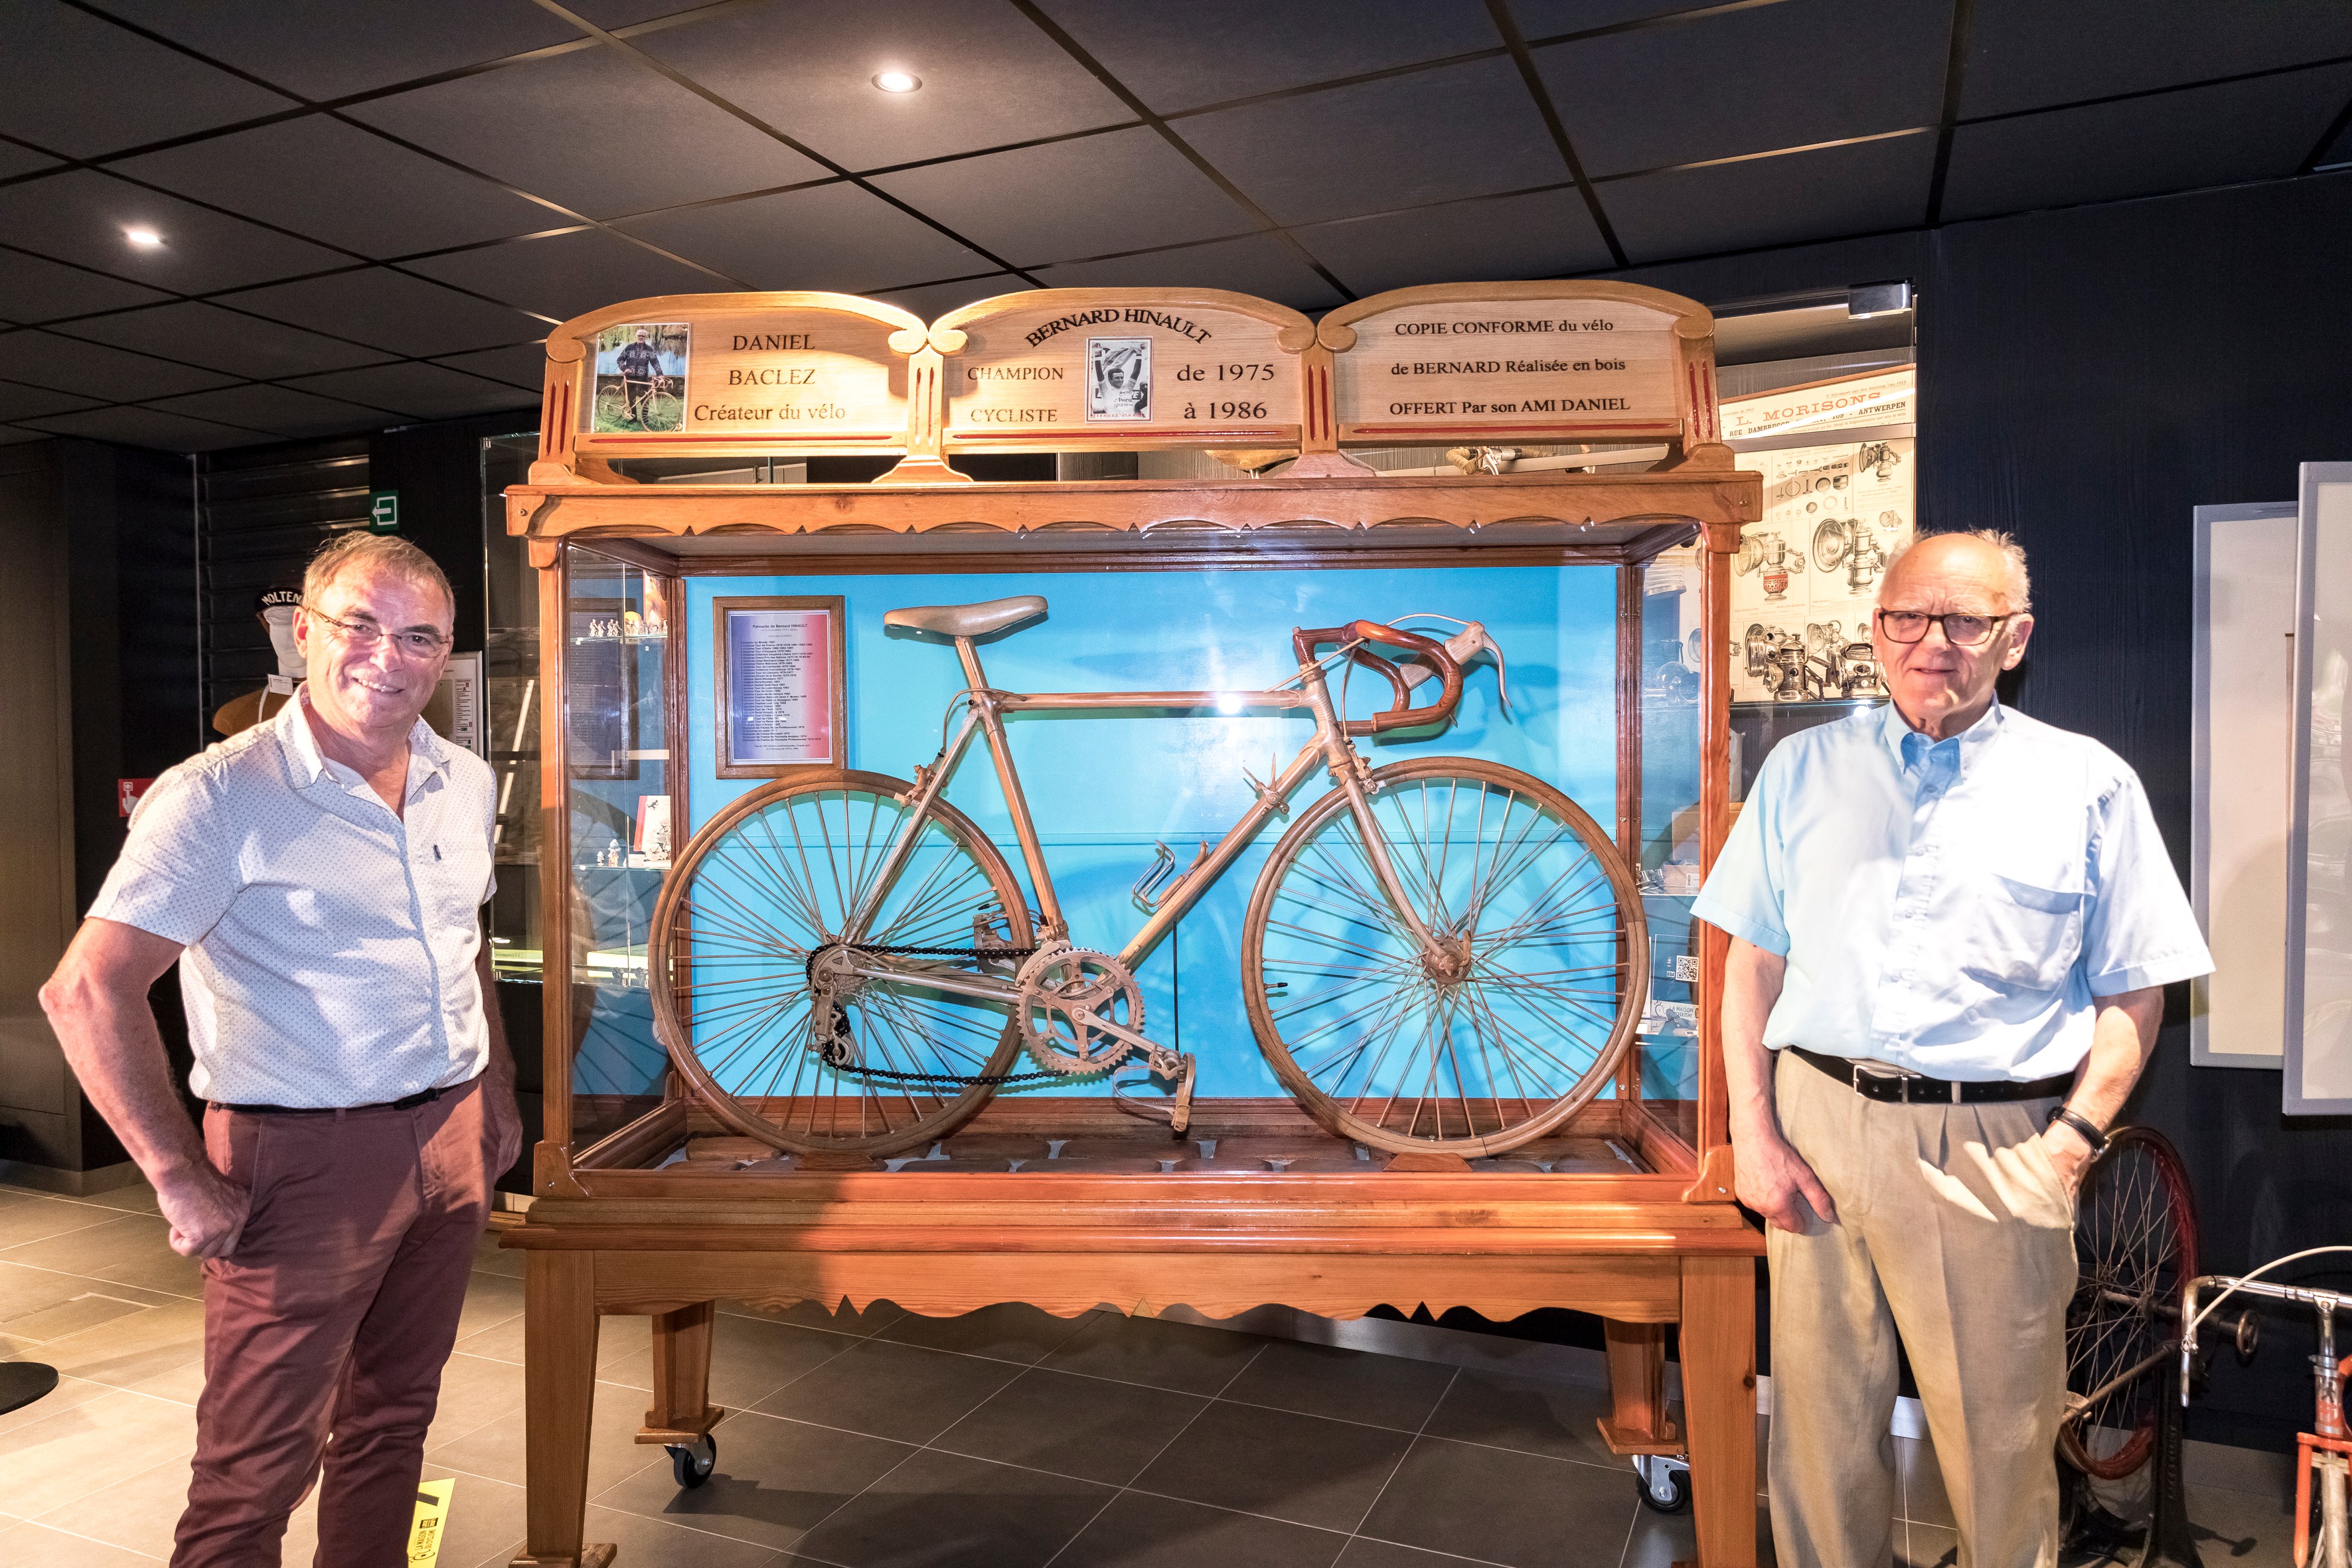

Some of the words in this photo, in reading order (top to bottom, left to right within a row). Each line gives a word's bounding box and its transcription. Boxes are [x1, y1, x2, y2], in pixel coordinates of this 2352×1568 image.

[1024, 308, 1120, 349] BERNARD
[1124, 308, 1212, 345] HINAULT
[1395, 323, 1448, 336] COPIE
[1452, 320, 1554, 335] CONFORME
[1558, 319, 1578, 333] du
[1581, 319, 1614, 332] vélo
[732, 335, 815, 351] DANIEL
[967, 366, 1064, 380] CHAMPION
[1177, 365, 1206, 382] de
[1217, 364, 1275, 382] 1975
[1391, 362, 1409, 375] de
[1413, 360, 1501, 374] BERNARD
[1505, 359, 1568, 374] Réalisée
[1573, 361, 1591, 372] en
[1595, 358, 1626, 371] bois
[728, 369, 815, 386] BACLEZ
[694, 404, 773, 422] Créateur
[778, 404, 801, 420] du
[807, 404, 846, 420] vélo
[971, 408, 1058, 423] CYCLISTE
[1184, 402, 1198, 420] à
[1209, 401, 1268, 420] 1986
[1389, 402, 1457, 416] OFFERT
[1462, 401, 1488, 414] Par
[1491, 402, 1517, 413] son
[1521, 400, 1556, 412] AMI
[1561, 398, 1631, 412] DANIEL
[1736, 416, 1753, 426] L.
[1763, 392, 1880, 422] MORISONS
[1859, 402, 1907, 415] ANTWERPEN
